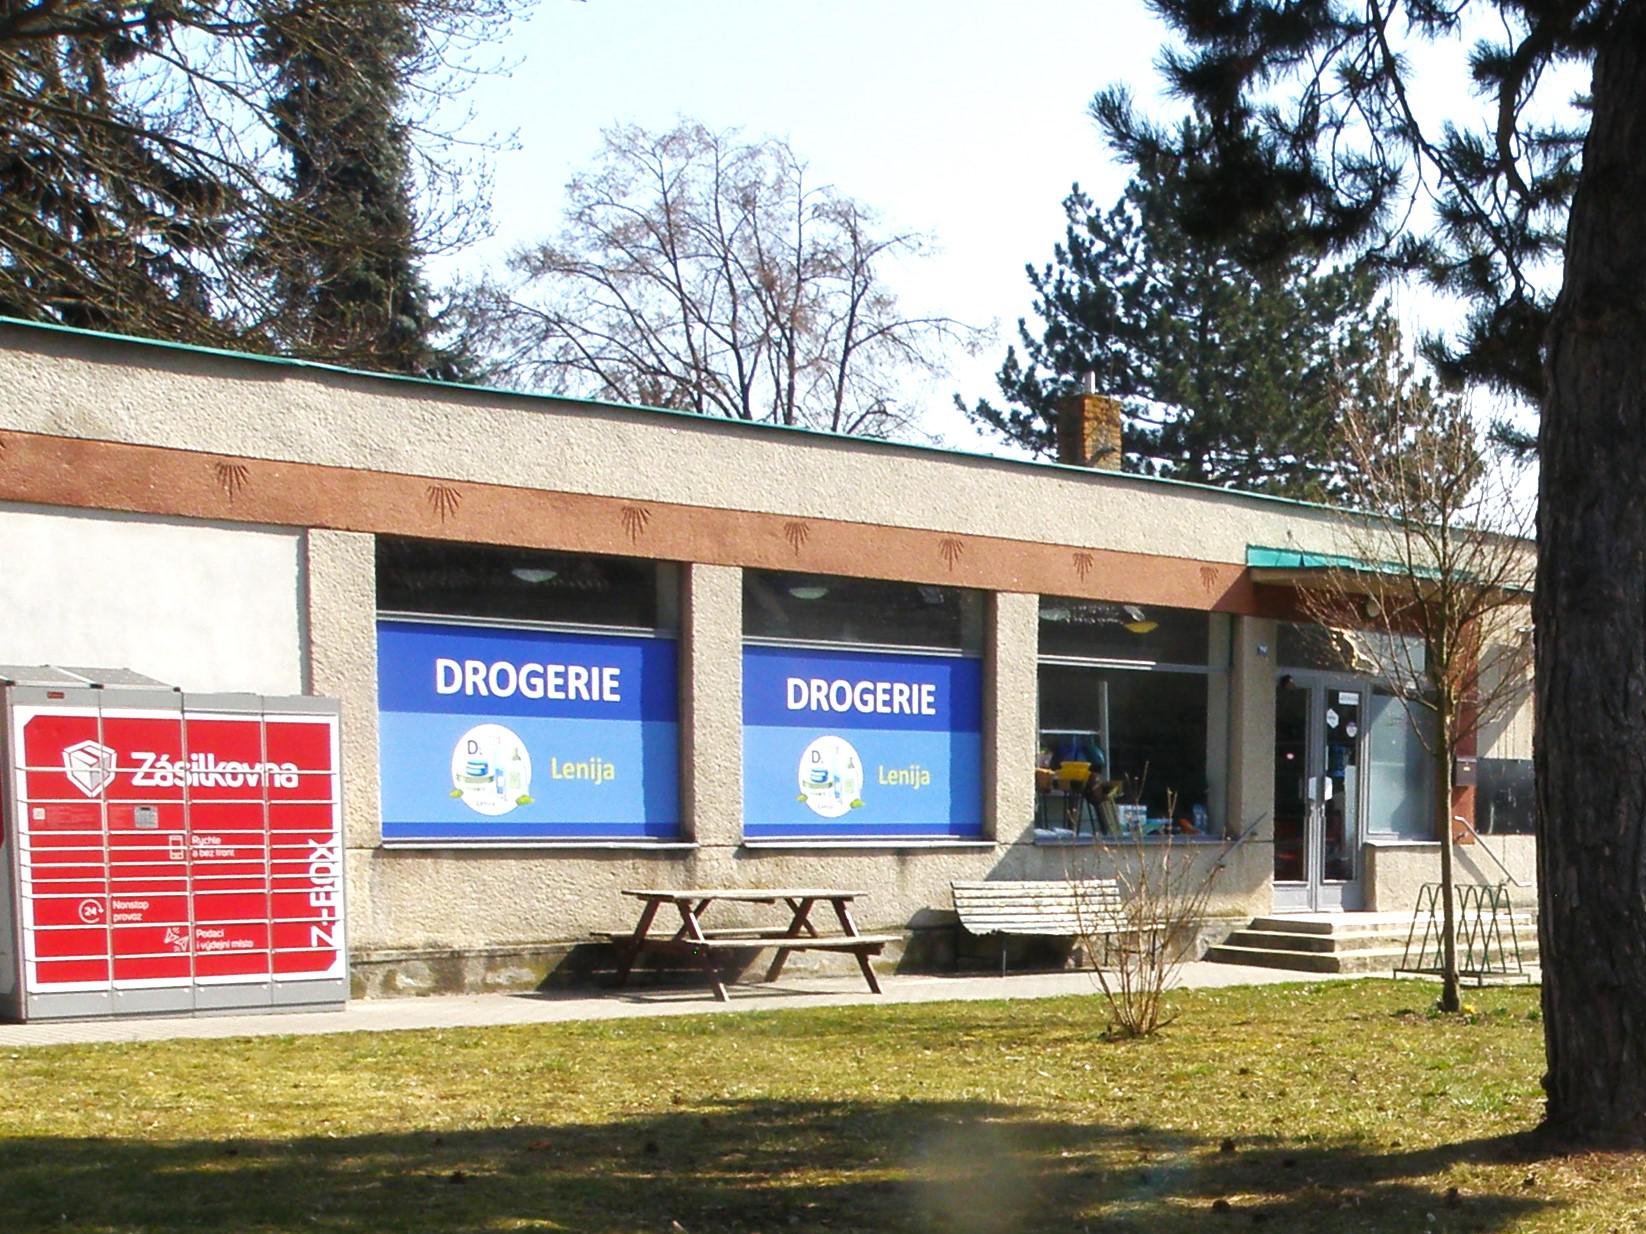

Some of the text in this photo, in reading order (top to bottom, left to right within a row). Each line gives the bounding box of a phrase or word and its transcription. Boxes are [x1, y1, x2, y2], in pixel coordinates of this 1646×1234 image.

[436, 658, 621, 702] DROGERIE
[787, 677, 936, 715] DROGERIE
[130, 751, 299, 788] Zásilkovna
[551, 757, 616, 785] Lenija
[878, 764, 931, 789] Lenija
[84, 907, 97, 916] 24
[113, 901, 149, 910] Nonstop
[113, 913, 142, 922] provoz
